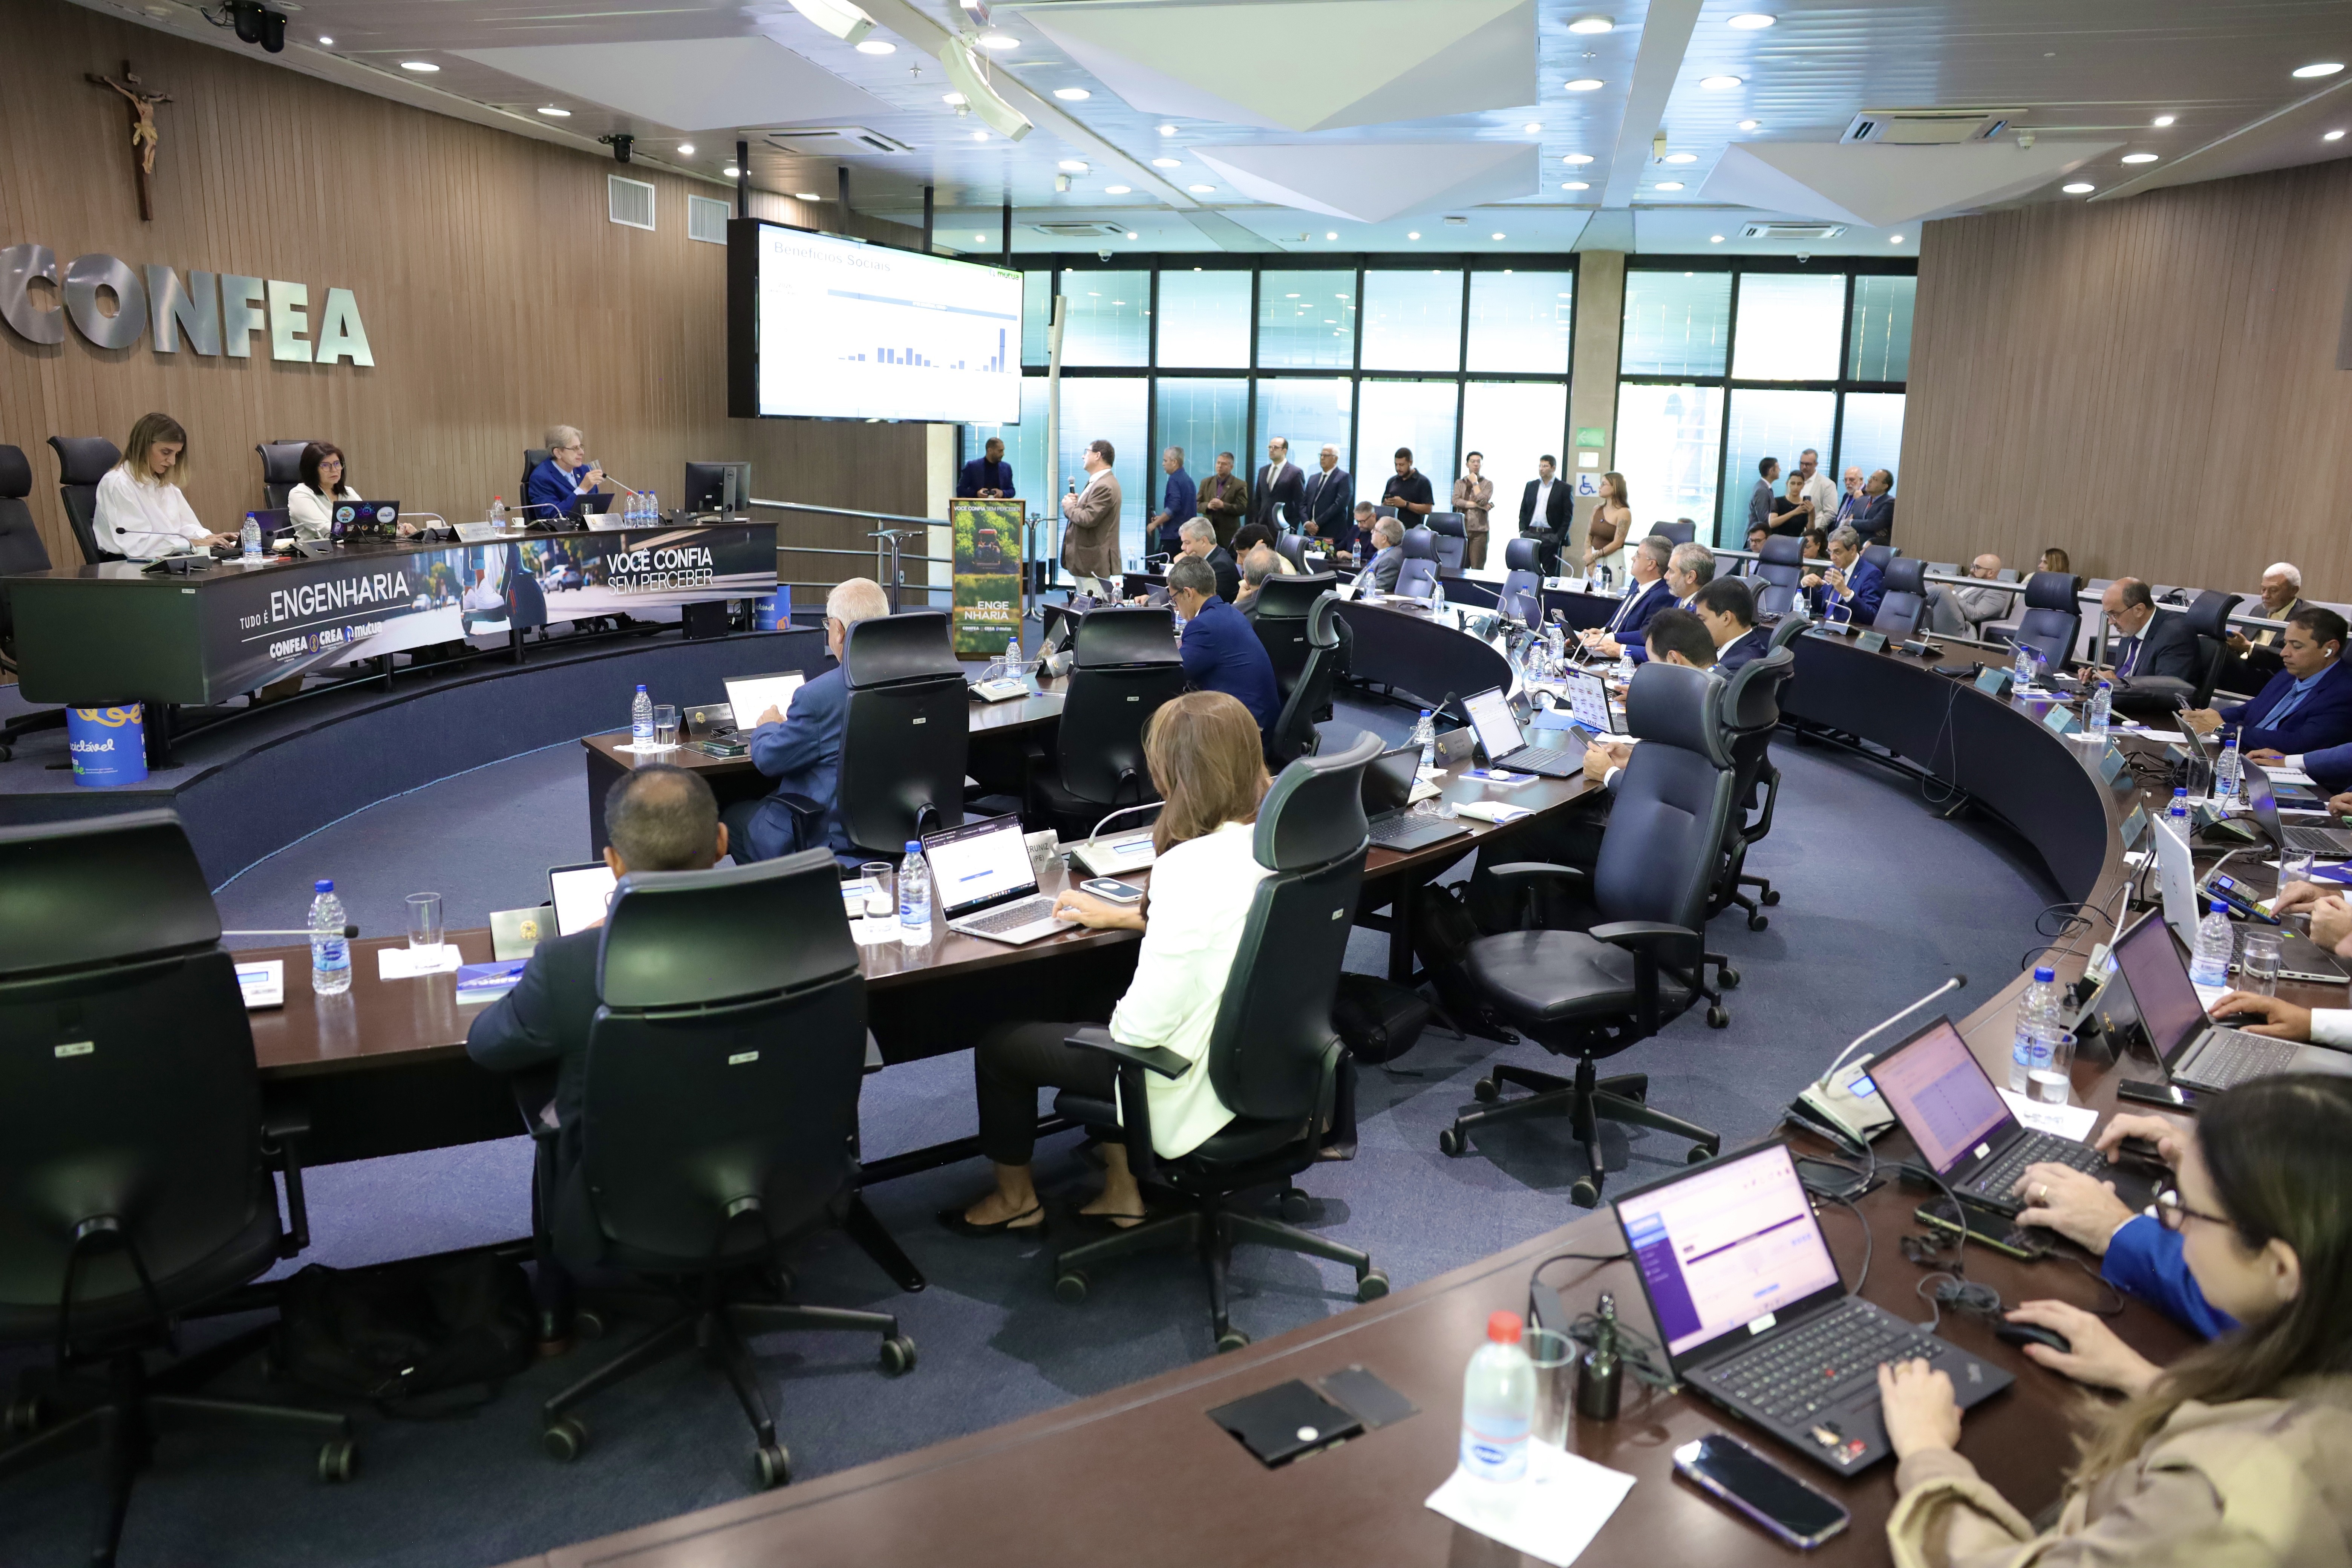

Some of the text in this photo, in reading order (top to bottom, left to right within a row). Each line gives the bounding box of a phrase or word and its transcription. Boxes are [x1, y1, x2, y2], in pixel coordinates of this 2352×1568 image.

[0, 243, 375, 367] CONFEA
[606, 547, 713, 573] VOCÊ CONFIA
[608, 568, 713, 596] SEM PERCEBER
[240, 571, 410, 630] TUDO É ENGENHARIA
[977, 601, 1009, 610] ENGE
[965, 611, 1009, 620] NHARIA
[270, 636, 308, 658] CONFEA
[319, 628, 343, 645] CREA
[1033, 854, 1044, 863] (PE)
